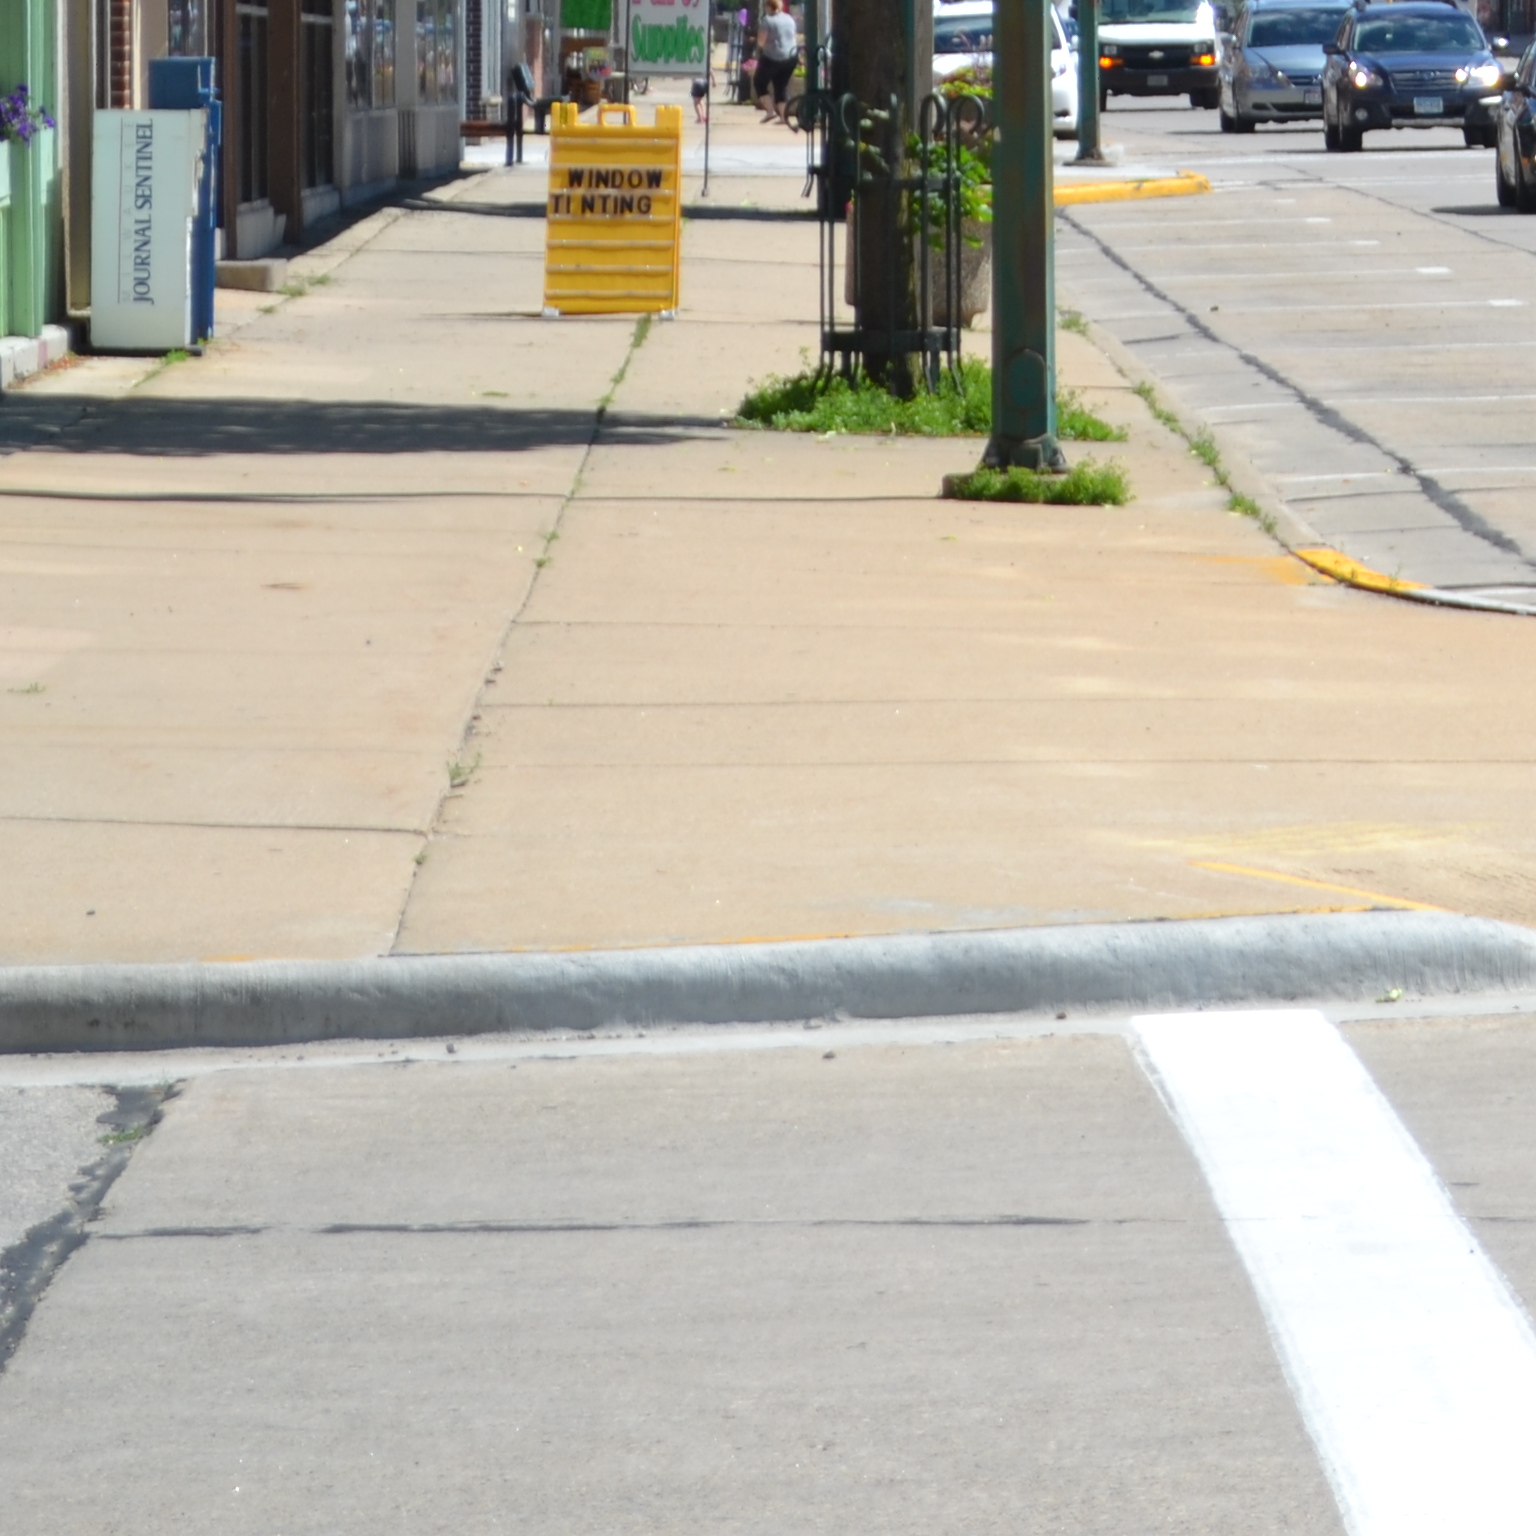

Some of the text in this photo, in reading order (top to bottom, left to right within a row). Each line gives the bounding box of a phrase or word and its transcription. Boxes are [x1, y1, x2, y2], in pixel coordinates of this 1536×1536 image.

[630, 14, 705, 64] Supplies
[568, 168, 663, 189] WINDOW
[133, 118, 154, 305] JOURNAL SENTINEL
